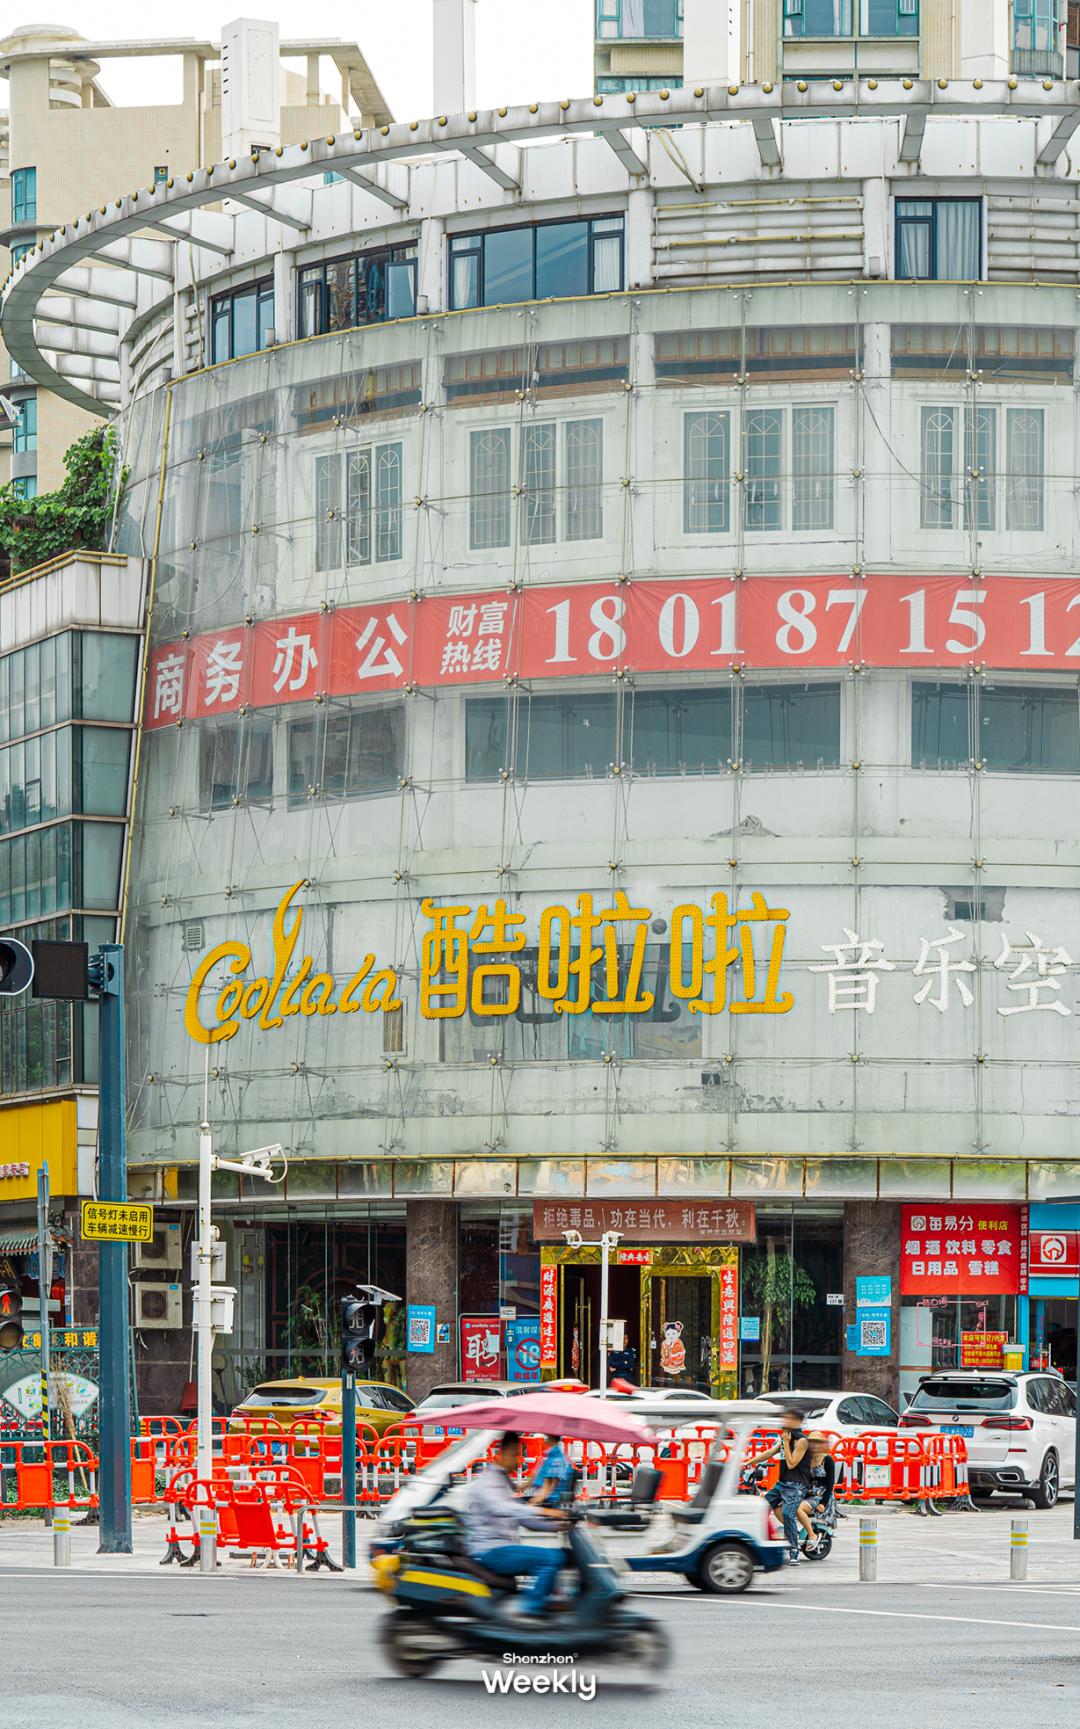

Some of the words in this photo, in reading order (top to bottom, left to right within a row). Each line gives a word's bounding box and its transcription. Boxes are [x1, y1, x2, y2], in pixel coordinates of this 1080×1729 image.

[446, 600, 509, 638] 财富
[153, 613, 408, 720] 商务办公
[440, 639, 503, 675] 热线
[420, 890, 795, 1019] 酷啦啦
[808, 926, 1074, 1017] 音乐空
[87, 1207, 148, 1223] 信号灯未启用
[978, 1220, 1009, 1231] 便利店
[87, 1222, 149, 1237] 车辆减速慢行
[912, 1261, 958, 1276] 日用品
